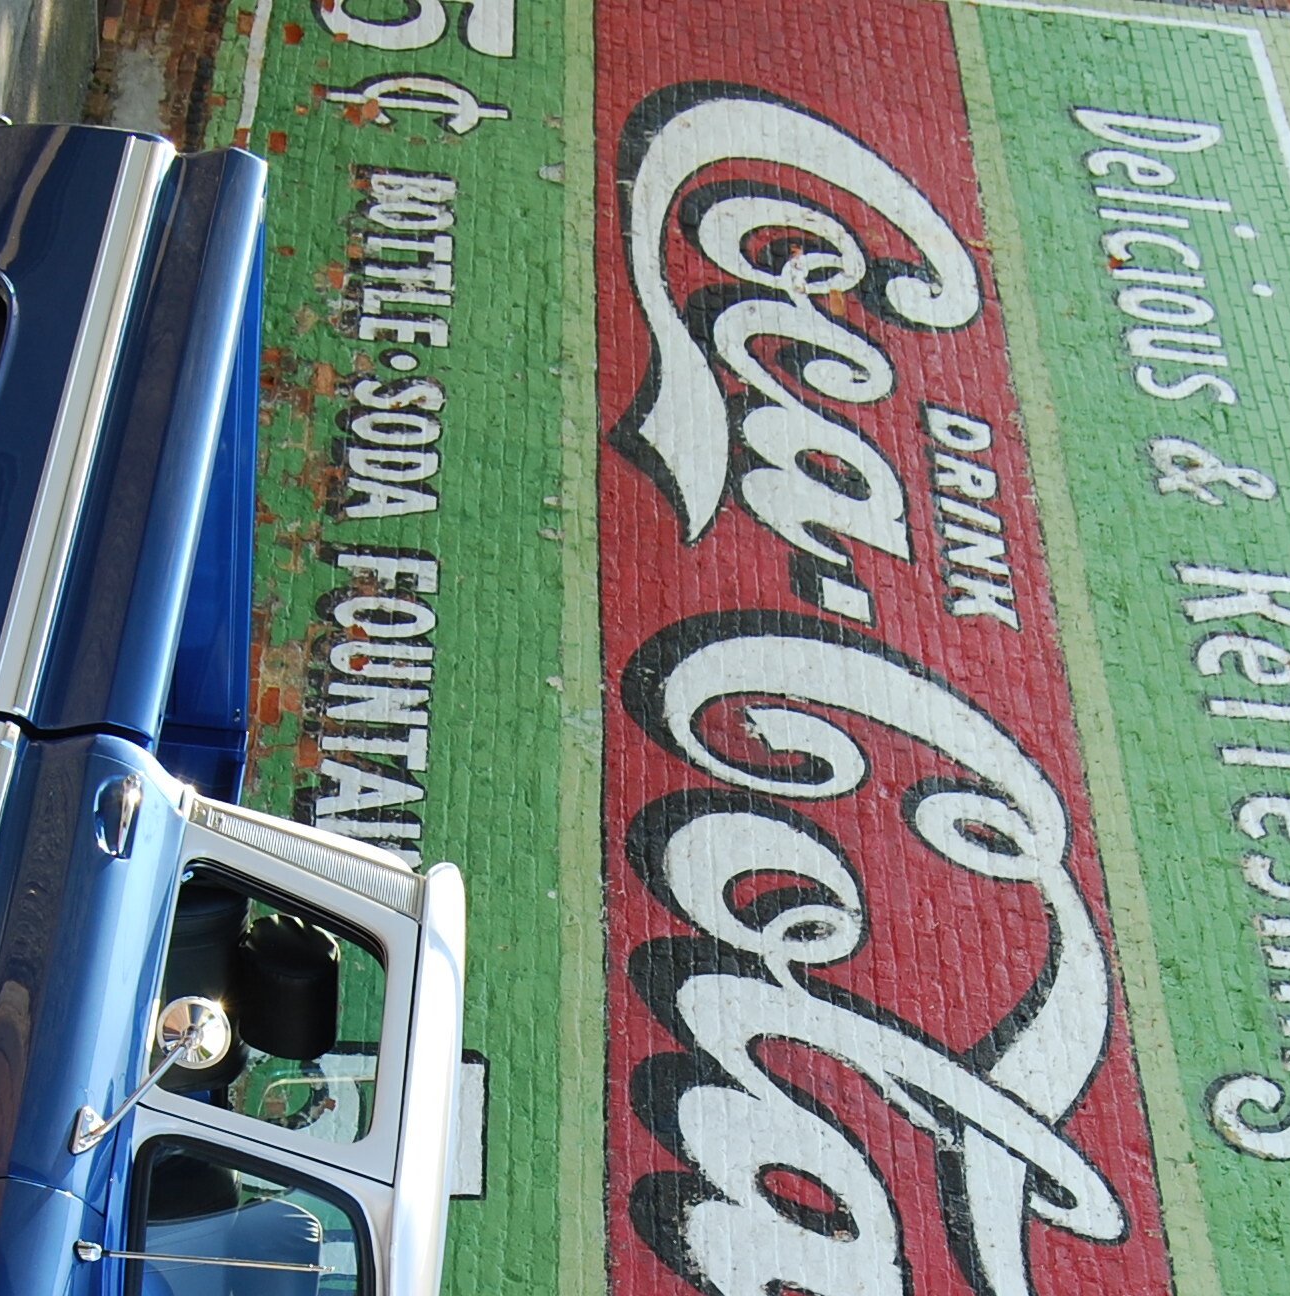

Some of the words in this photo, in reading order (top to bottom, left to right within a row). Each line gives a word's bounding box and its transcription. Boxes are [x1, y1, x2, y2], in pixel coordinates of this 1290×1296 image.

[1071, 107, 1275, 405] Delicious
[920, 403, 1022, 634] DRINK
[1146, 437, 1281, 507] &
[296, 545, 442, 872] FOUNTAI
